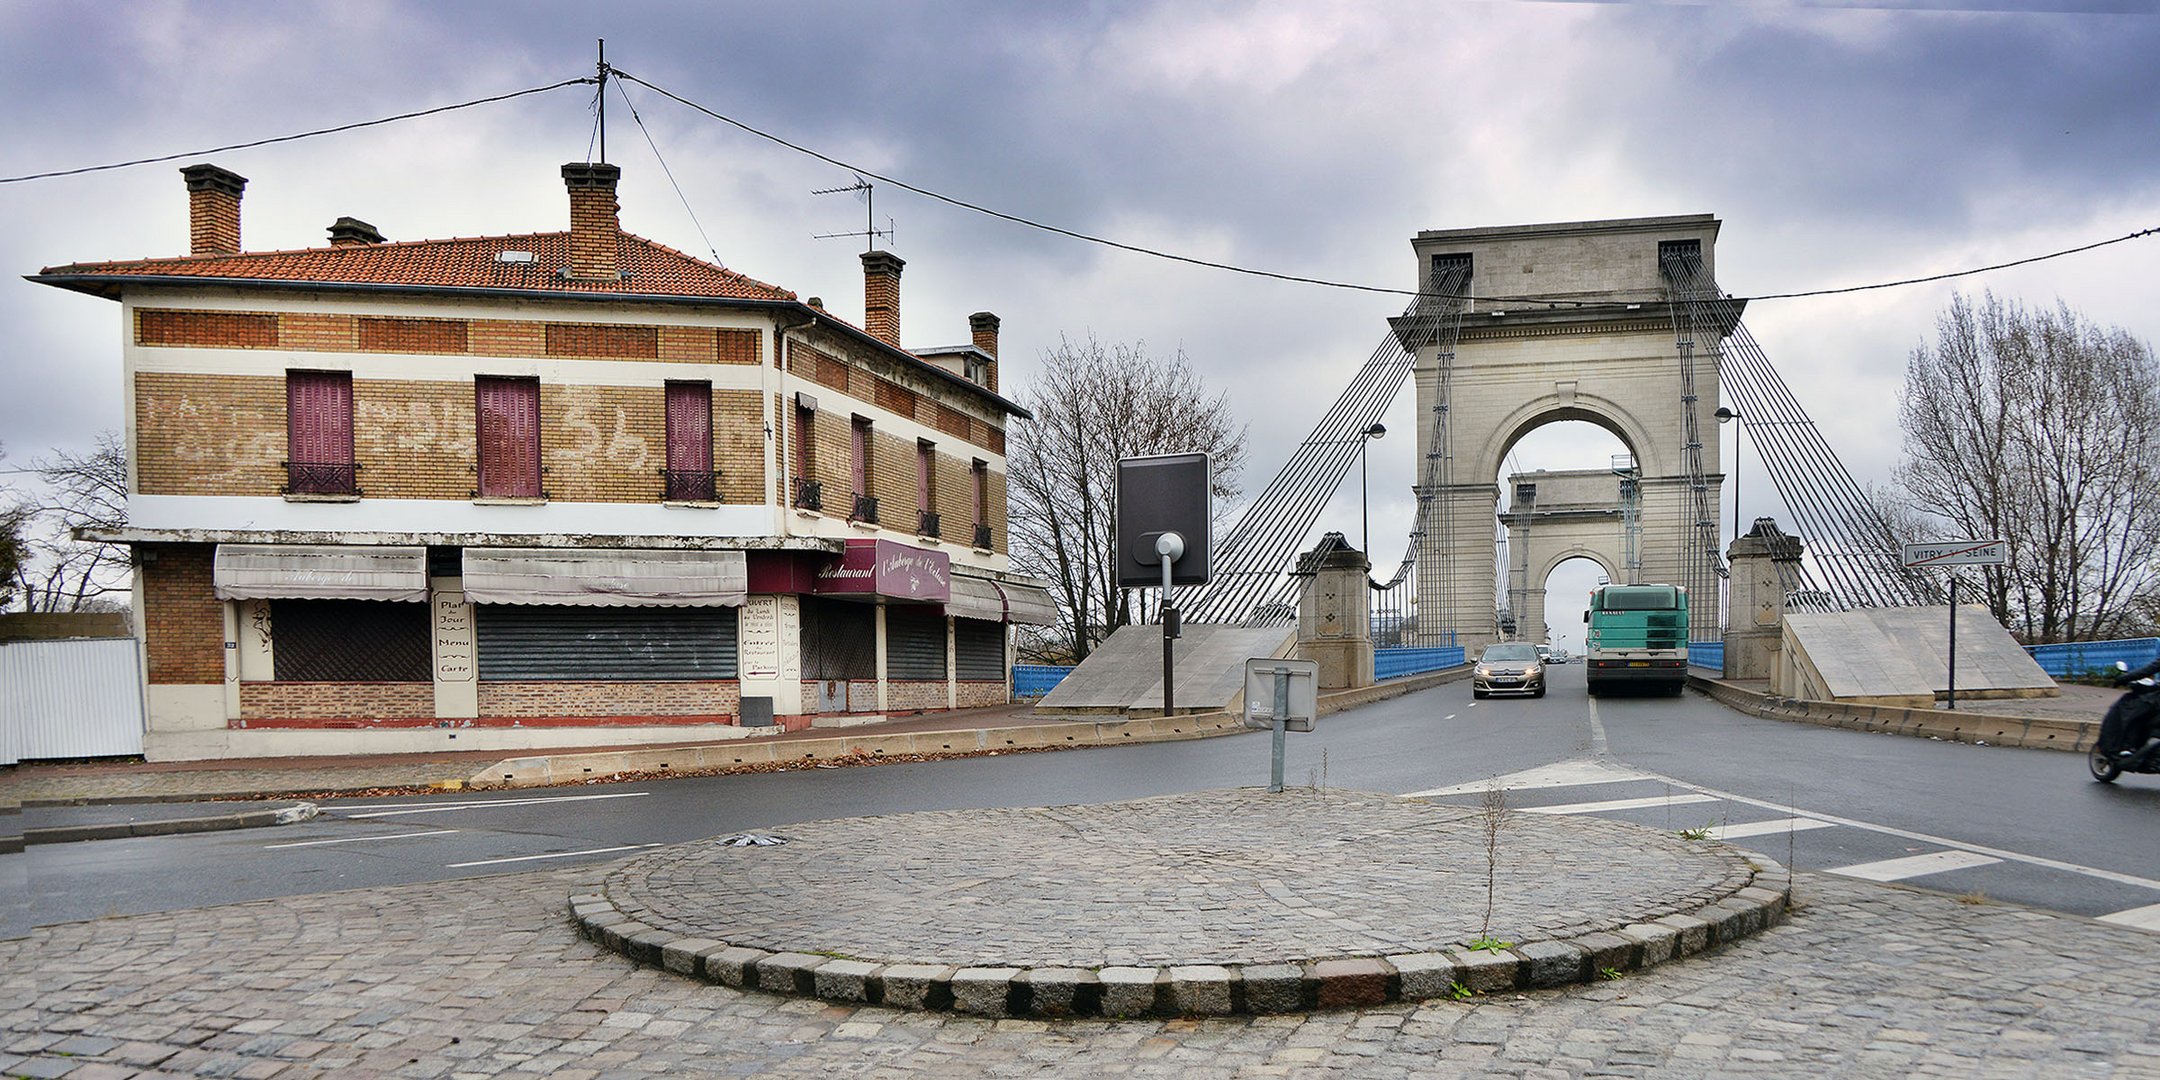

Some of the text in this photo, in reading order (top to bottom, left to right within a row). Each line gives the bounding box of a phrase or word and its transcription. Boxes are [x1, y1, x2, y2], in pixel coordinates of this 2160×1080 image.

[1913, 550, 1943, 559] VITRY
[1965, 547, 1997, 558] SEINE
[818, 563, 876, 579] Restaurant
[440, 601, 464, 609] Plat
[440, 615, 465, 624] Jour
[439, 638, 469, 647] Menu
[441, 664, 469, 673] Carte
